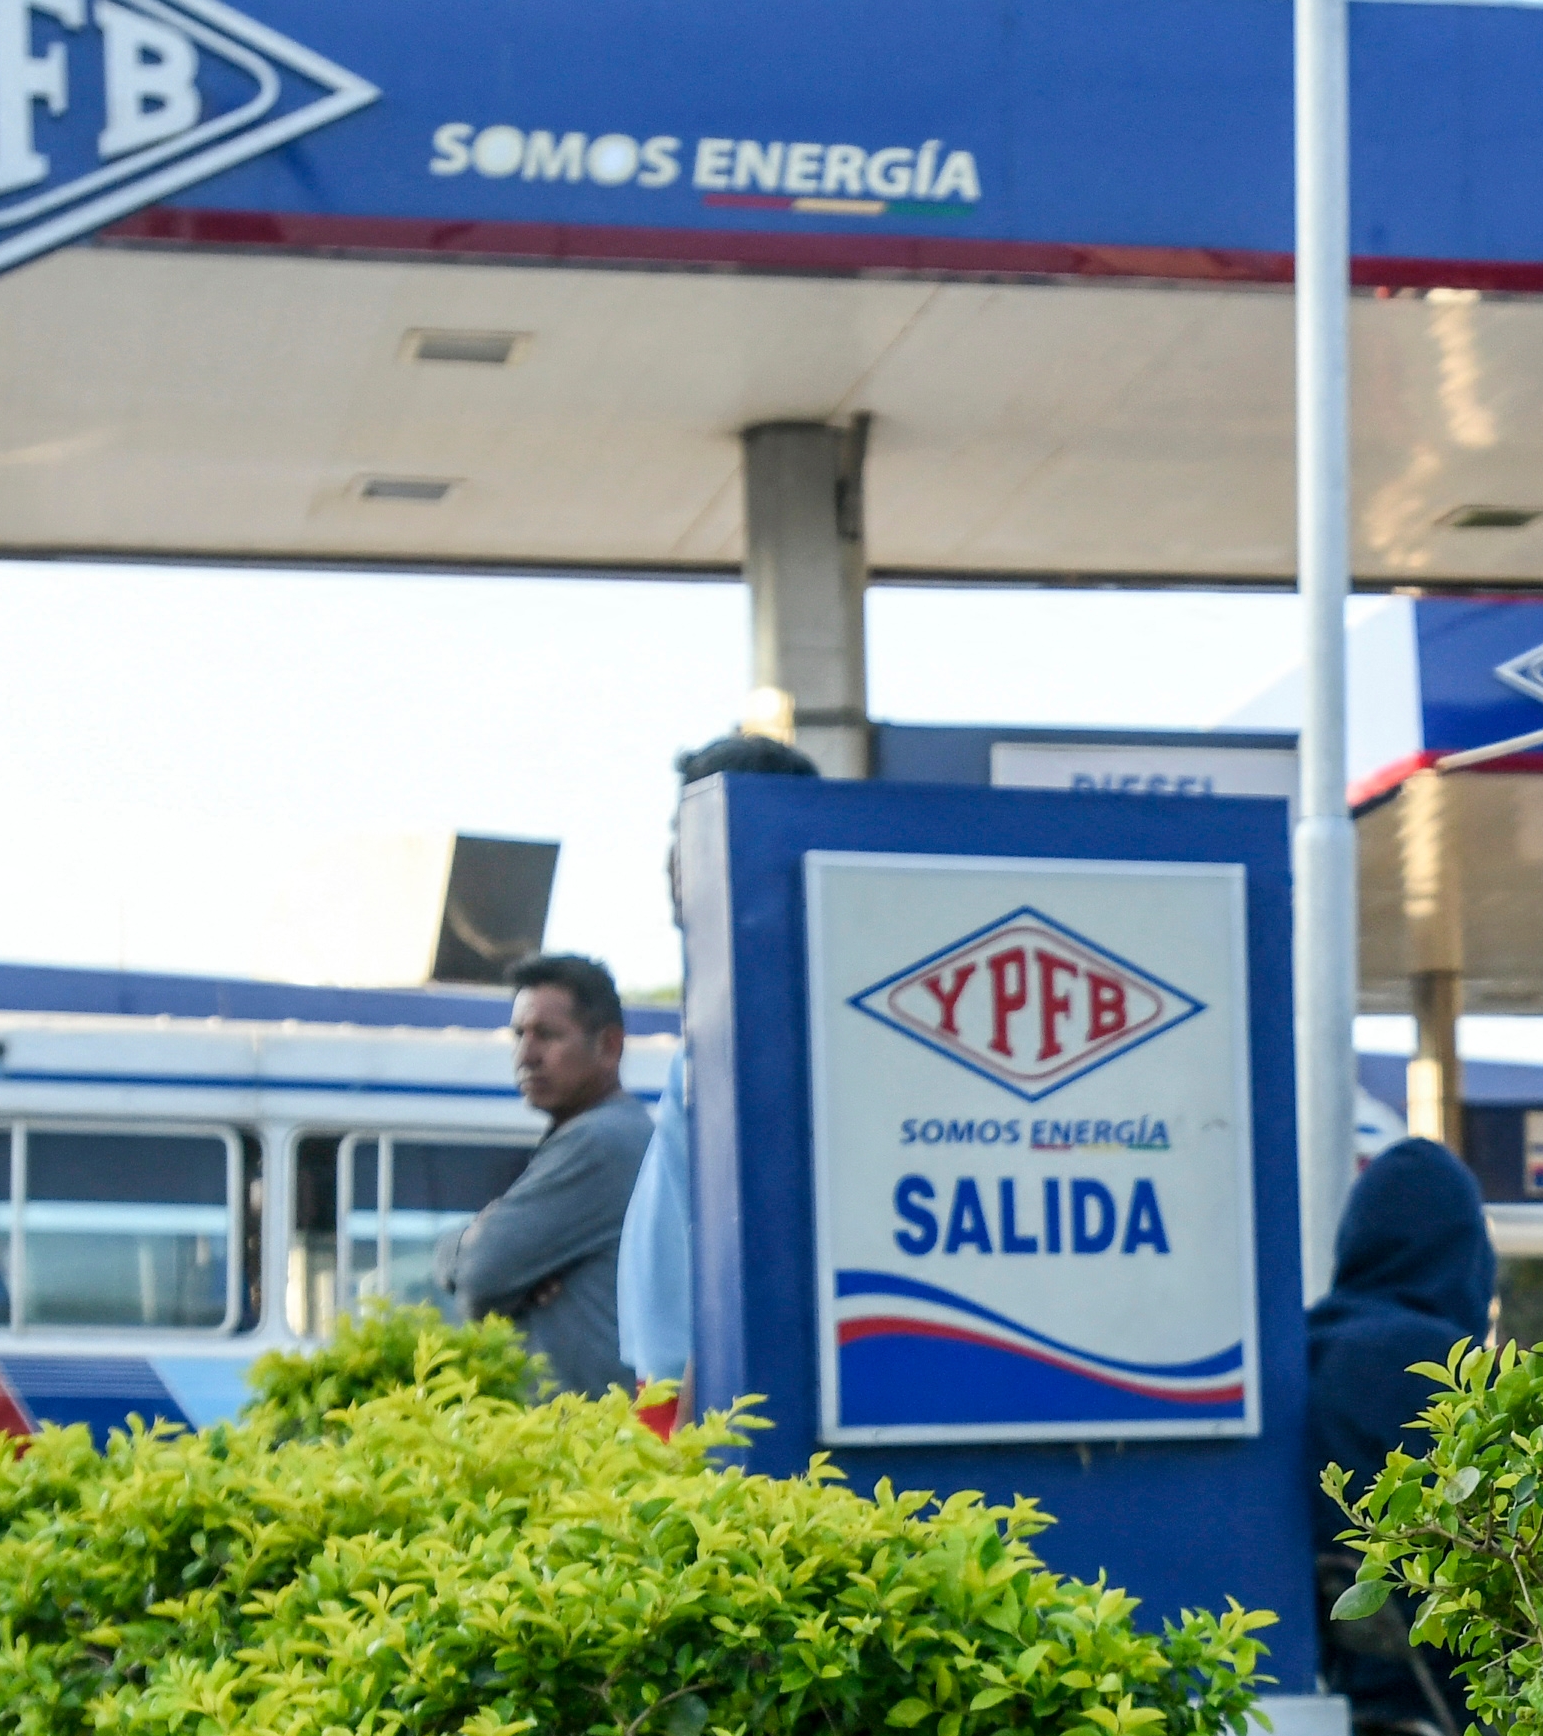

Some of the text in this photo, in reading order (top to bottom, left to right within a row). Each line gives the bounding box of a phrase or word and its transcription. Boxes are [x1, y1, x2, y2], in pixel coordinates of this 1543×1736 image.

[429, 122, 981, 202] SOMOS ENERGÍA
[921, 946, 1128, 1062] YPFB
[900, 1114, 1171, 1145] SOMOS ENERGÍA
[892, 1172, 1171, 1257] SALIDA
